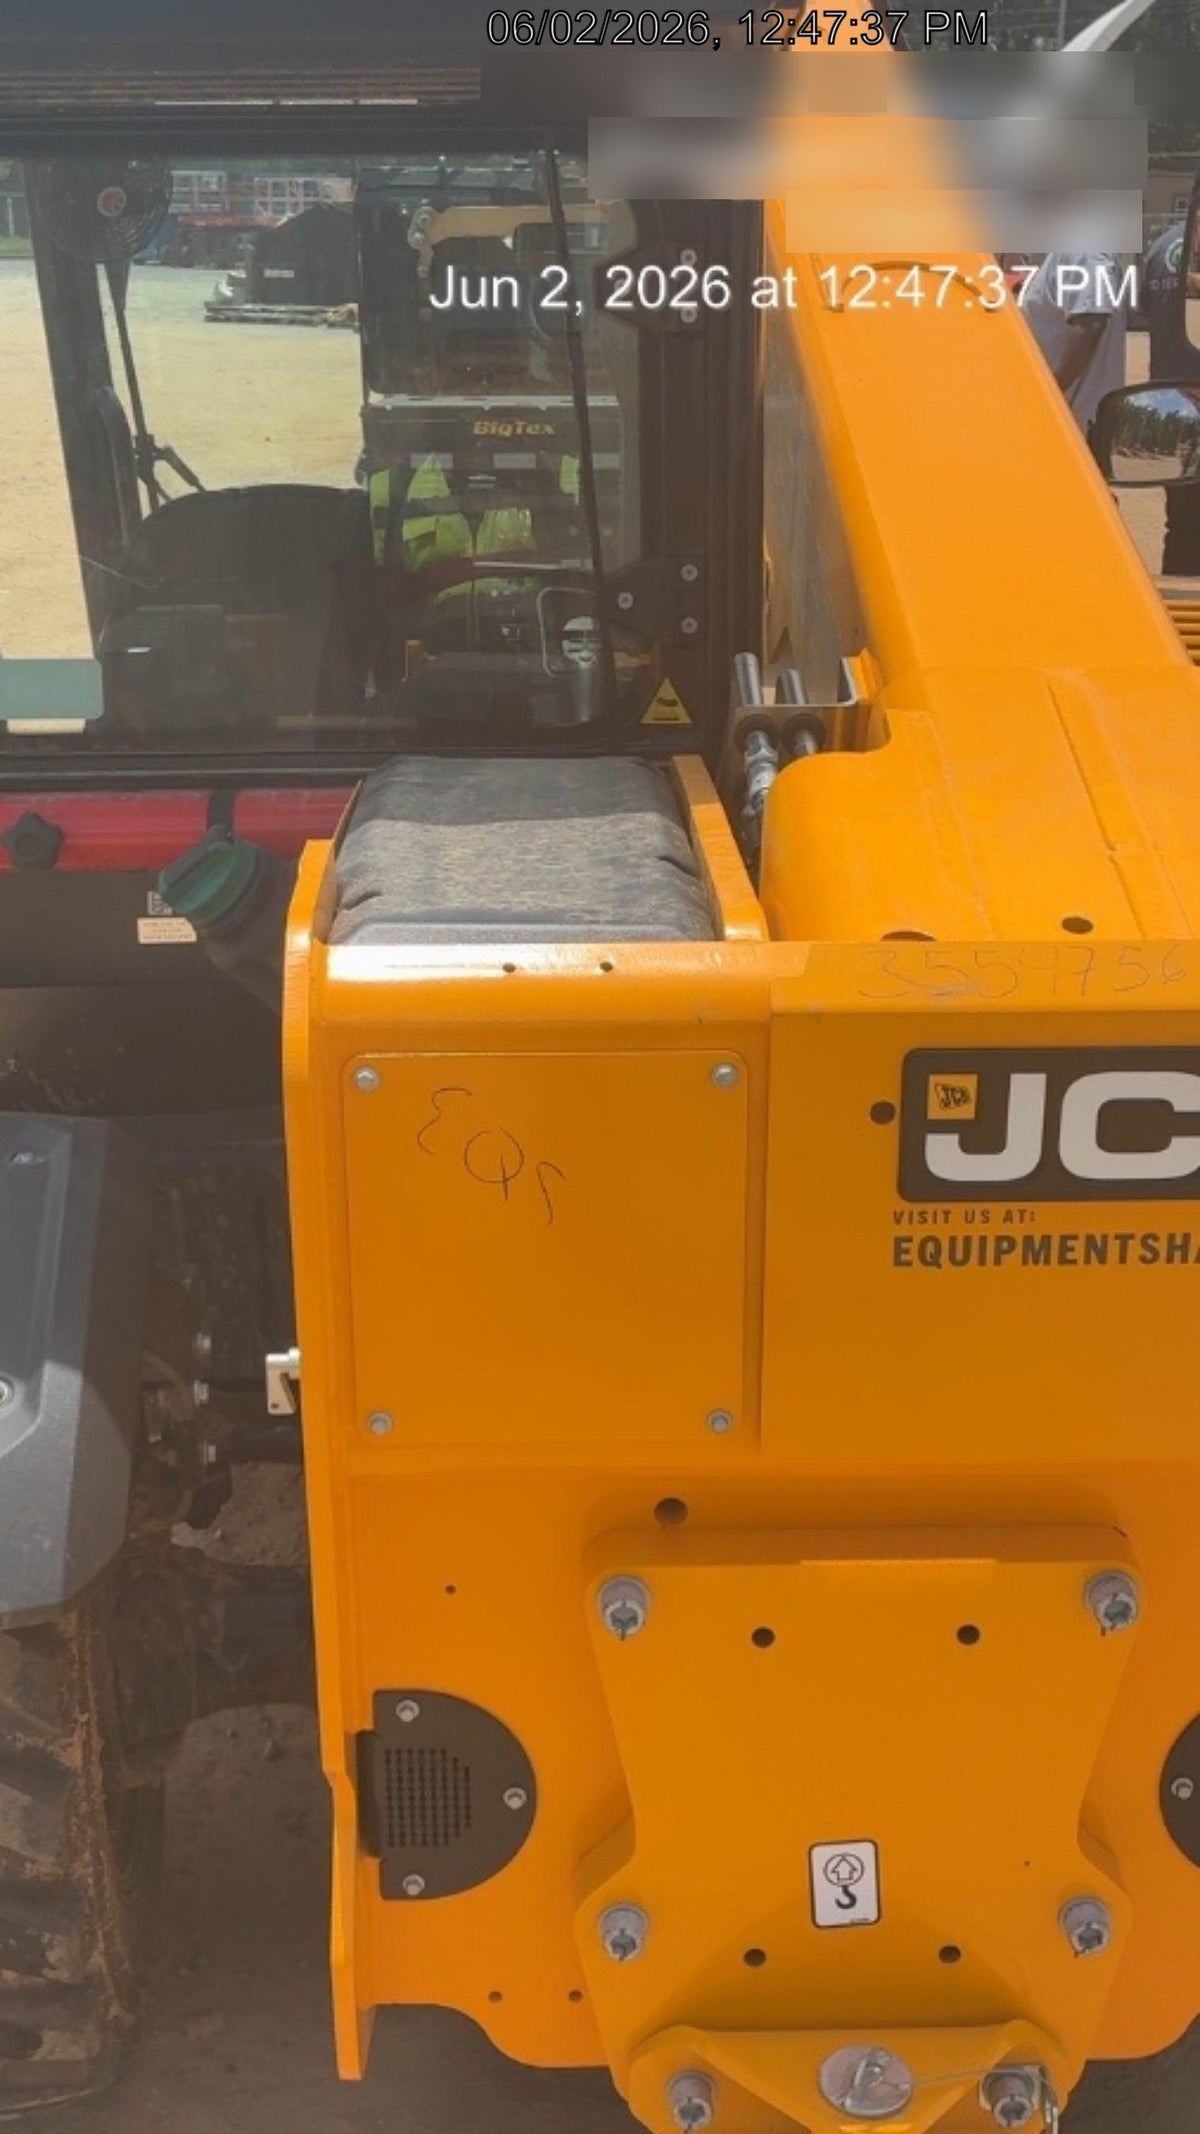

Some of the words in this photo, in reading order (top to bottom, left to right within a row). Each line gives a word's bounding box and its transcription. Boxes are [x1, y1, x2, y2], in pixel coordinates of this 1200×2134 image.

[473, 421, 556, 438] BigTex
[893, 1210, 952, 1226] VISIT
[964, 1209, 991, 1225] US
[1002, 1208, 1036, 1225] AT:
